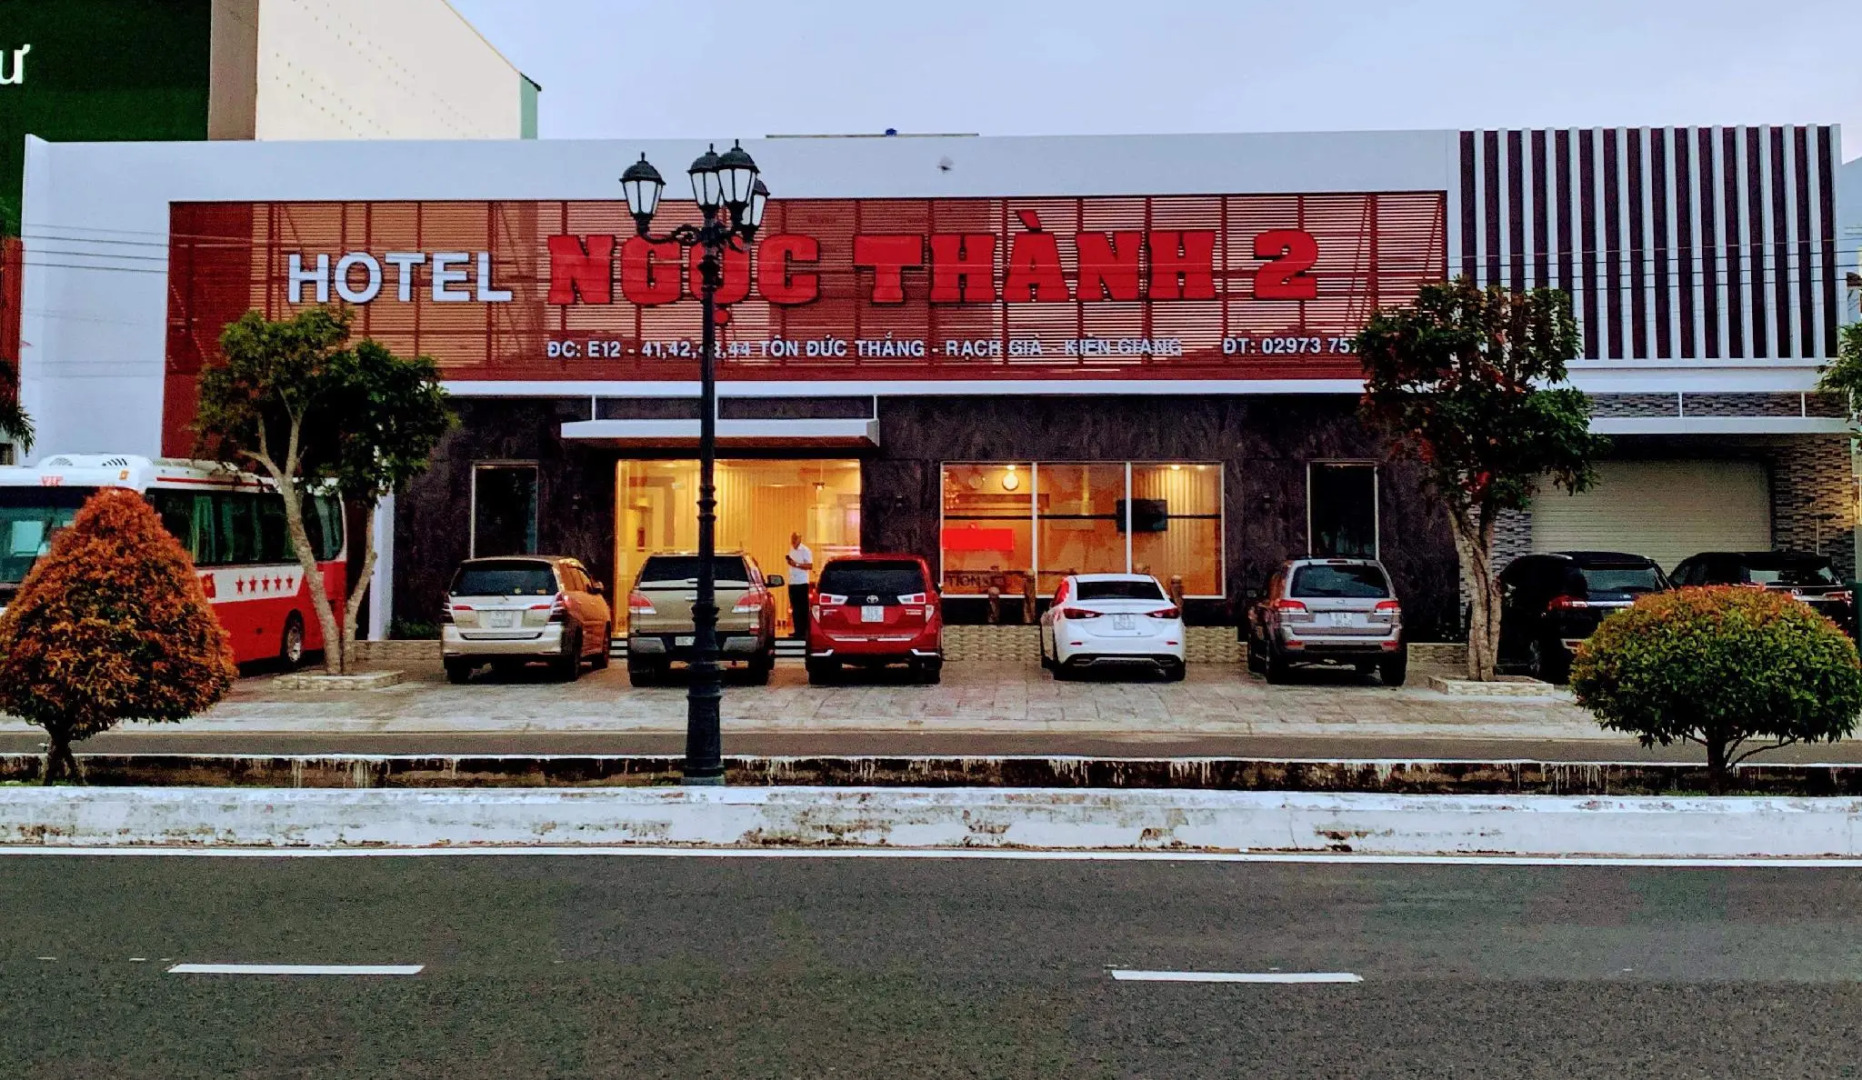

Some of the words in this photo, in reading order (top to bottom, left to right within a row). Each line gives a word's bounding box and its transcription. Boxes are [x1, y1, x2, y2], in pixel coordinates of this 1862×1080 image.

[288, 252, 512, 303] HOTEL
[548, 233, 820, 326] NGỌC
[853, 210, 1217, 303] THÀNH
[1253, 229, 1318, 299] 2
[547, 340, 581, 358] ĐC:
[587, 340, 621, 358] E12
[641, 340, 751, 359] 41,42,3,44
[760, 334, 798, 357] TÔN
[806, 334, 847, 357] ĐỨC
[945, 339, 1001, 360] RẠCH
[1064, 333, 1111, 356] KIÊN
[1118, 338, 1182, 356] GIANG
[1223, 337, 1256, 354] ĐT:
[1262, 337, 1322, 354] 02973
